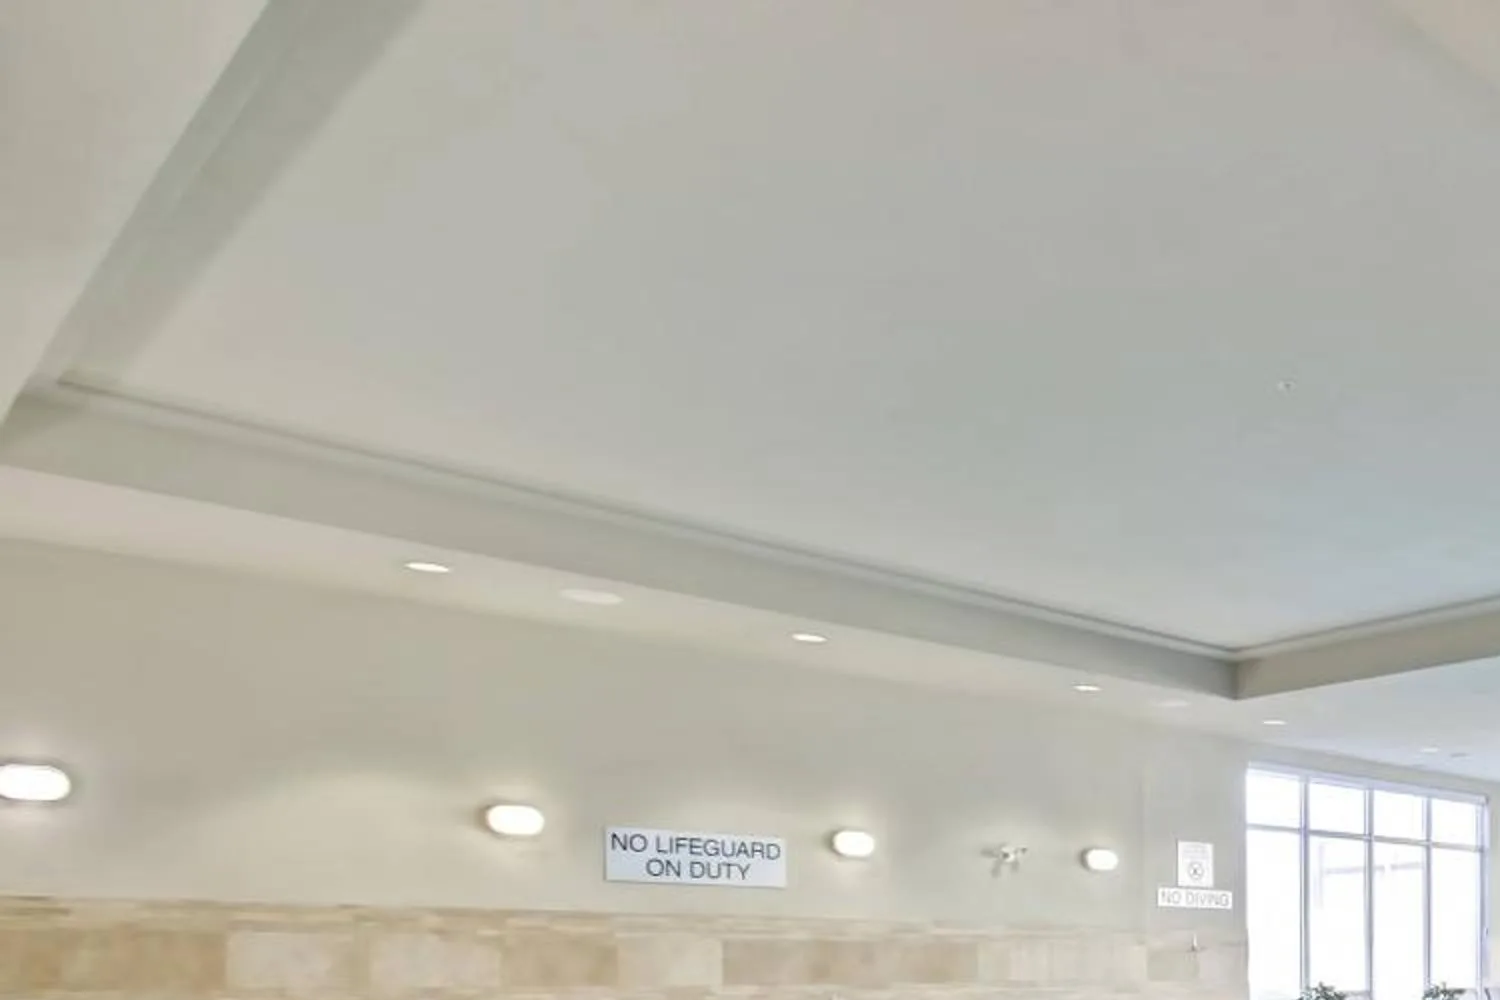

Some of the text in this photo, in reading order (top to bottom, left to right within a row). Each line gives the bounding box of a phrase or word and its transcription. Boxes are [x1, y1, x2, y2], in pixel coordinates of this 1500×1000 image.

[610, 833, 781, 860] NO LIFEGUARD
[646, 858, 750, 880] ON DUTY
[1161, 890, 1230, 906] NO DIVING
